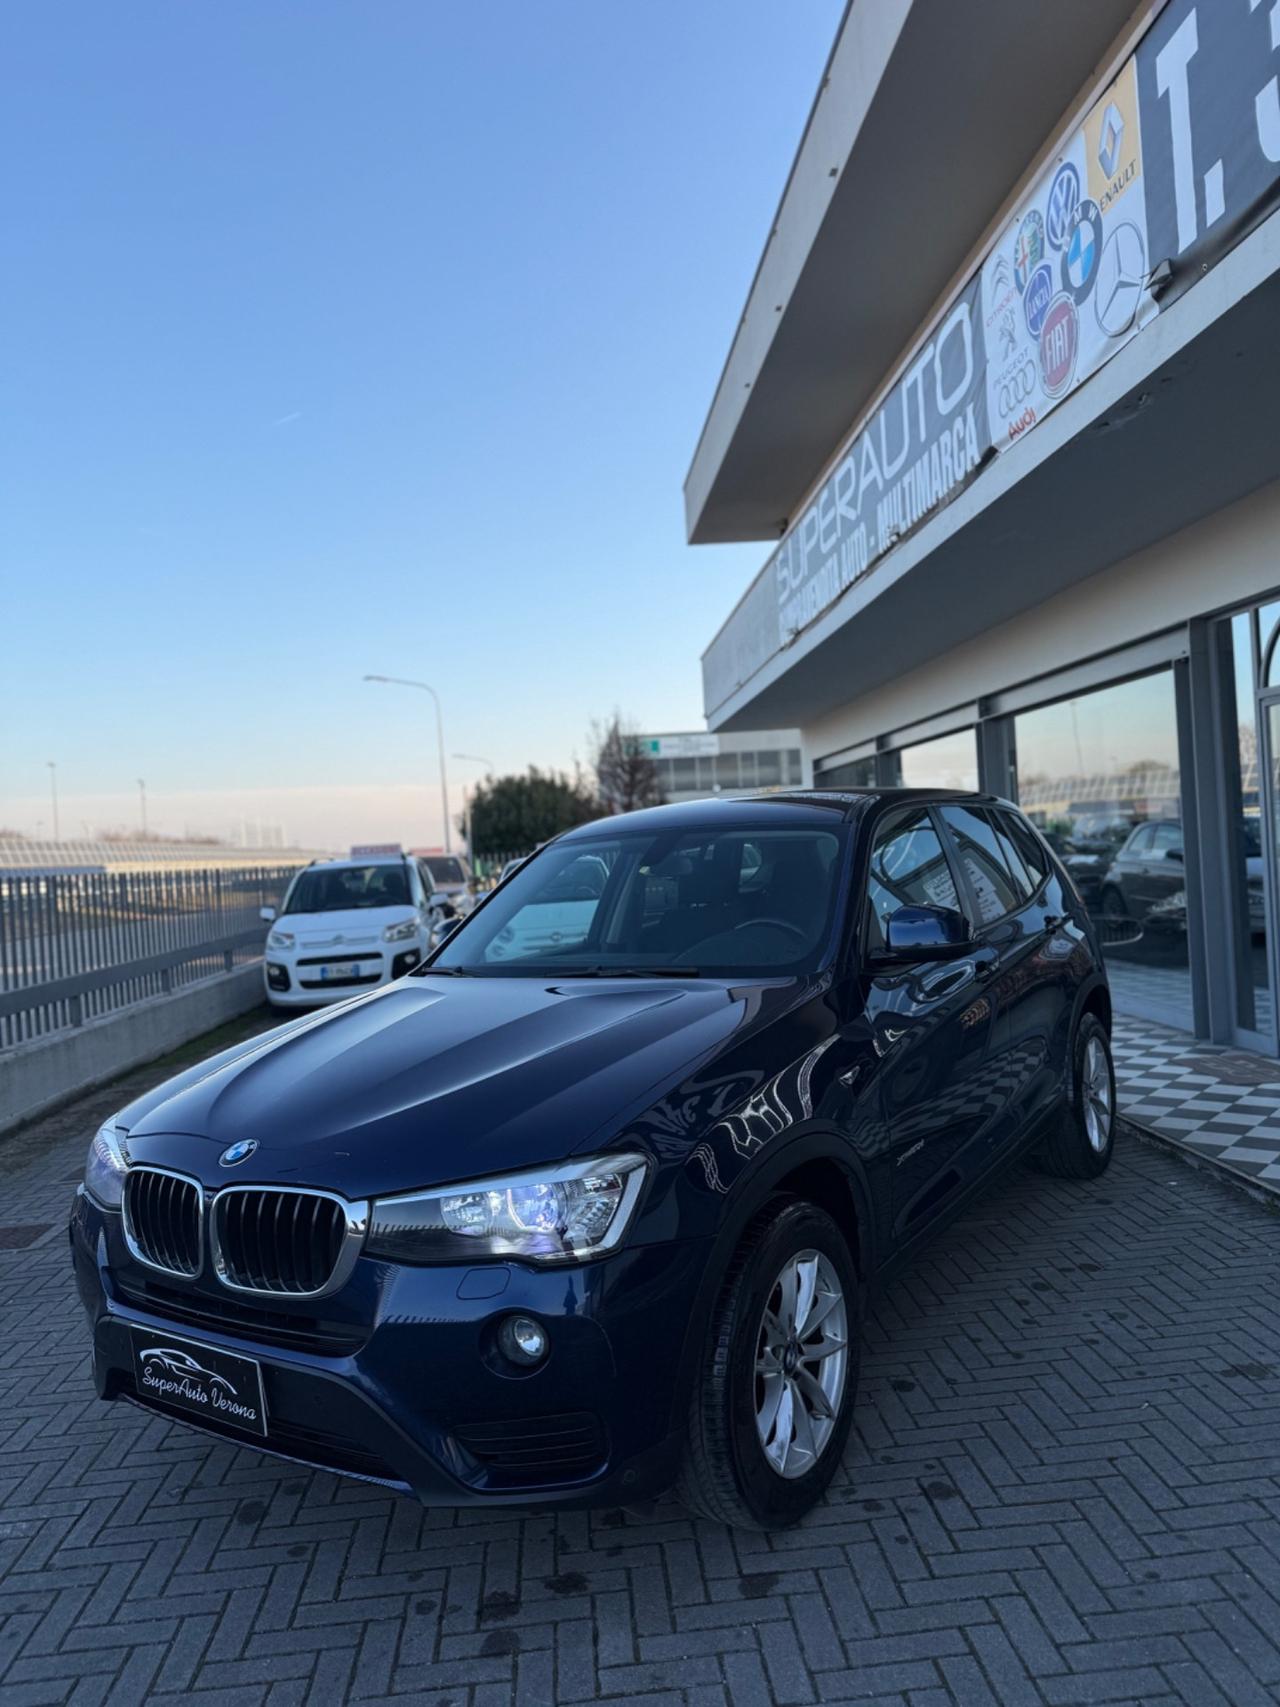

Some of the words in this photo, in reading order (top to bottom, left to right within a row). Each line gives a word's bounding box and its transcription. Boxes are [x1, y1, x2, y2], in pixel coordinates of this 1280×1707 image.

[1100, 158, 1137, 212] ENAULT
[1045, 315, 1070, 375] FIAT
[1008, 407, 1037, 440] Audi
[776, 302, 974, 606] SUPERAUTO
[841, 521, 868, 590] AUTO
[876, 402, 981, 555] MULTIMARCA
[143, 1366, 208, 1403] SuperAuto
[211, 1387, 257, 1420] Verona
